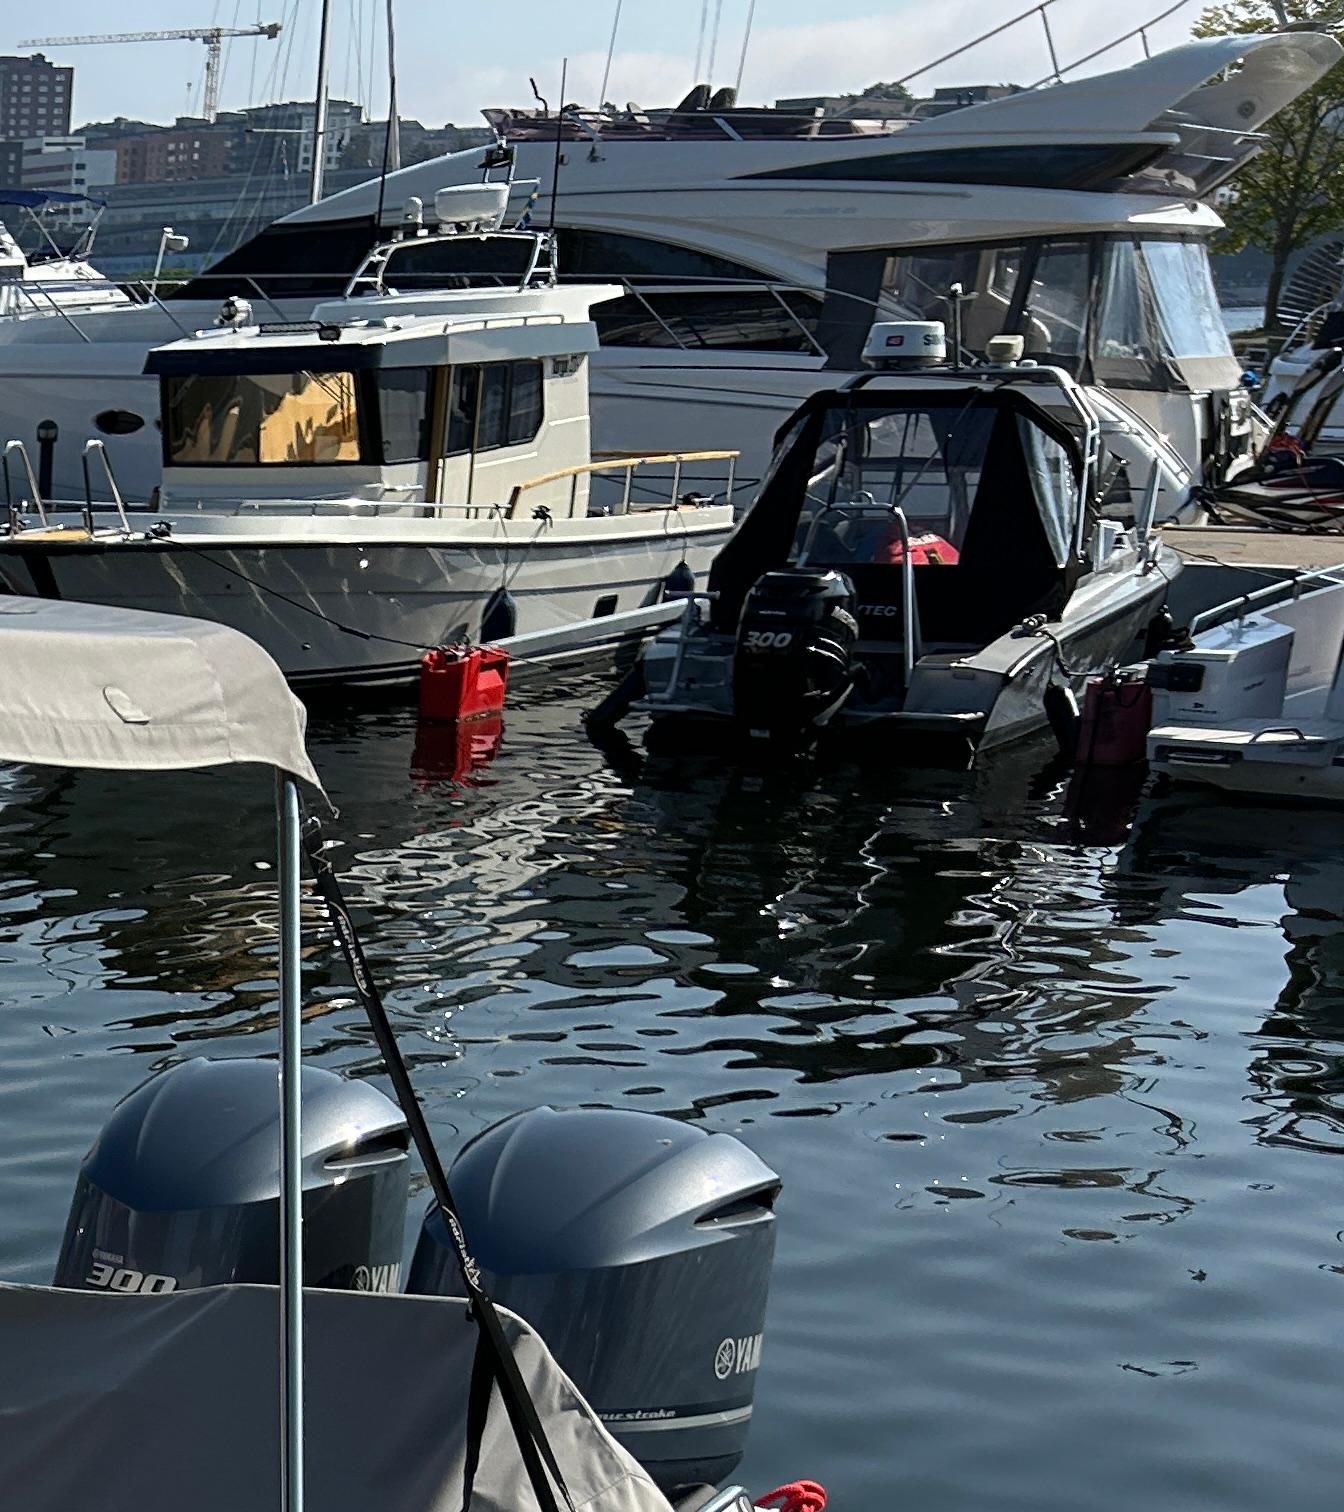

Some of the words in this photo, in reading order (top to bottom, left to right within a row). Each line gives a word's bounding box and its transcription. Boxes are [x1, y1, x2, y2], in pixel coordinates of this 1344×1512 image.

[858, 604, 898, 617] TEC
[742, 630, 792, 648] 300
[85, 1262, 177, 1294] 300
